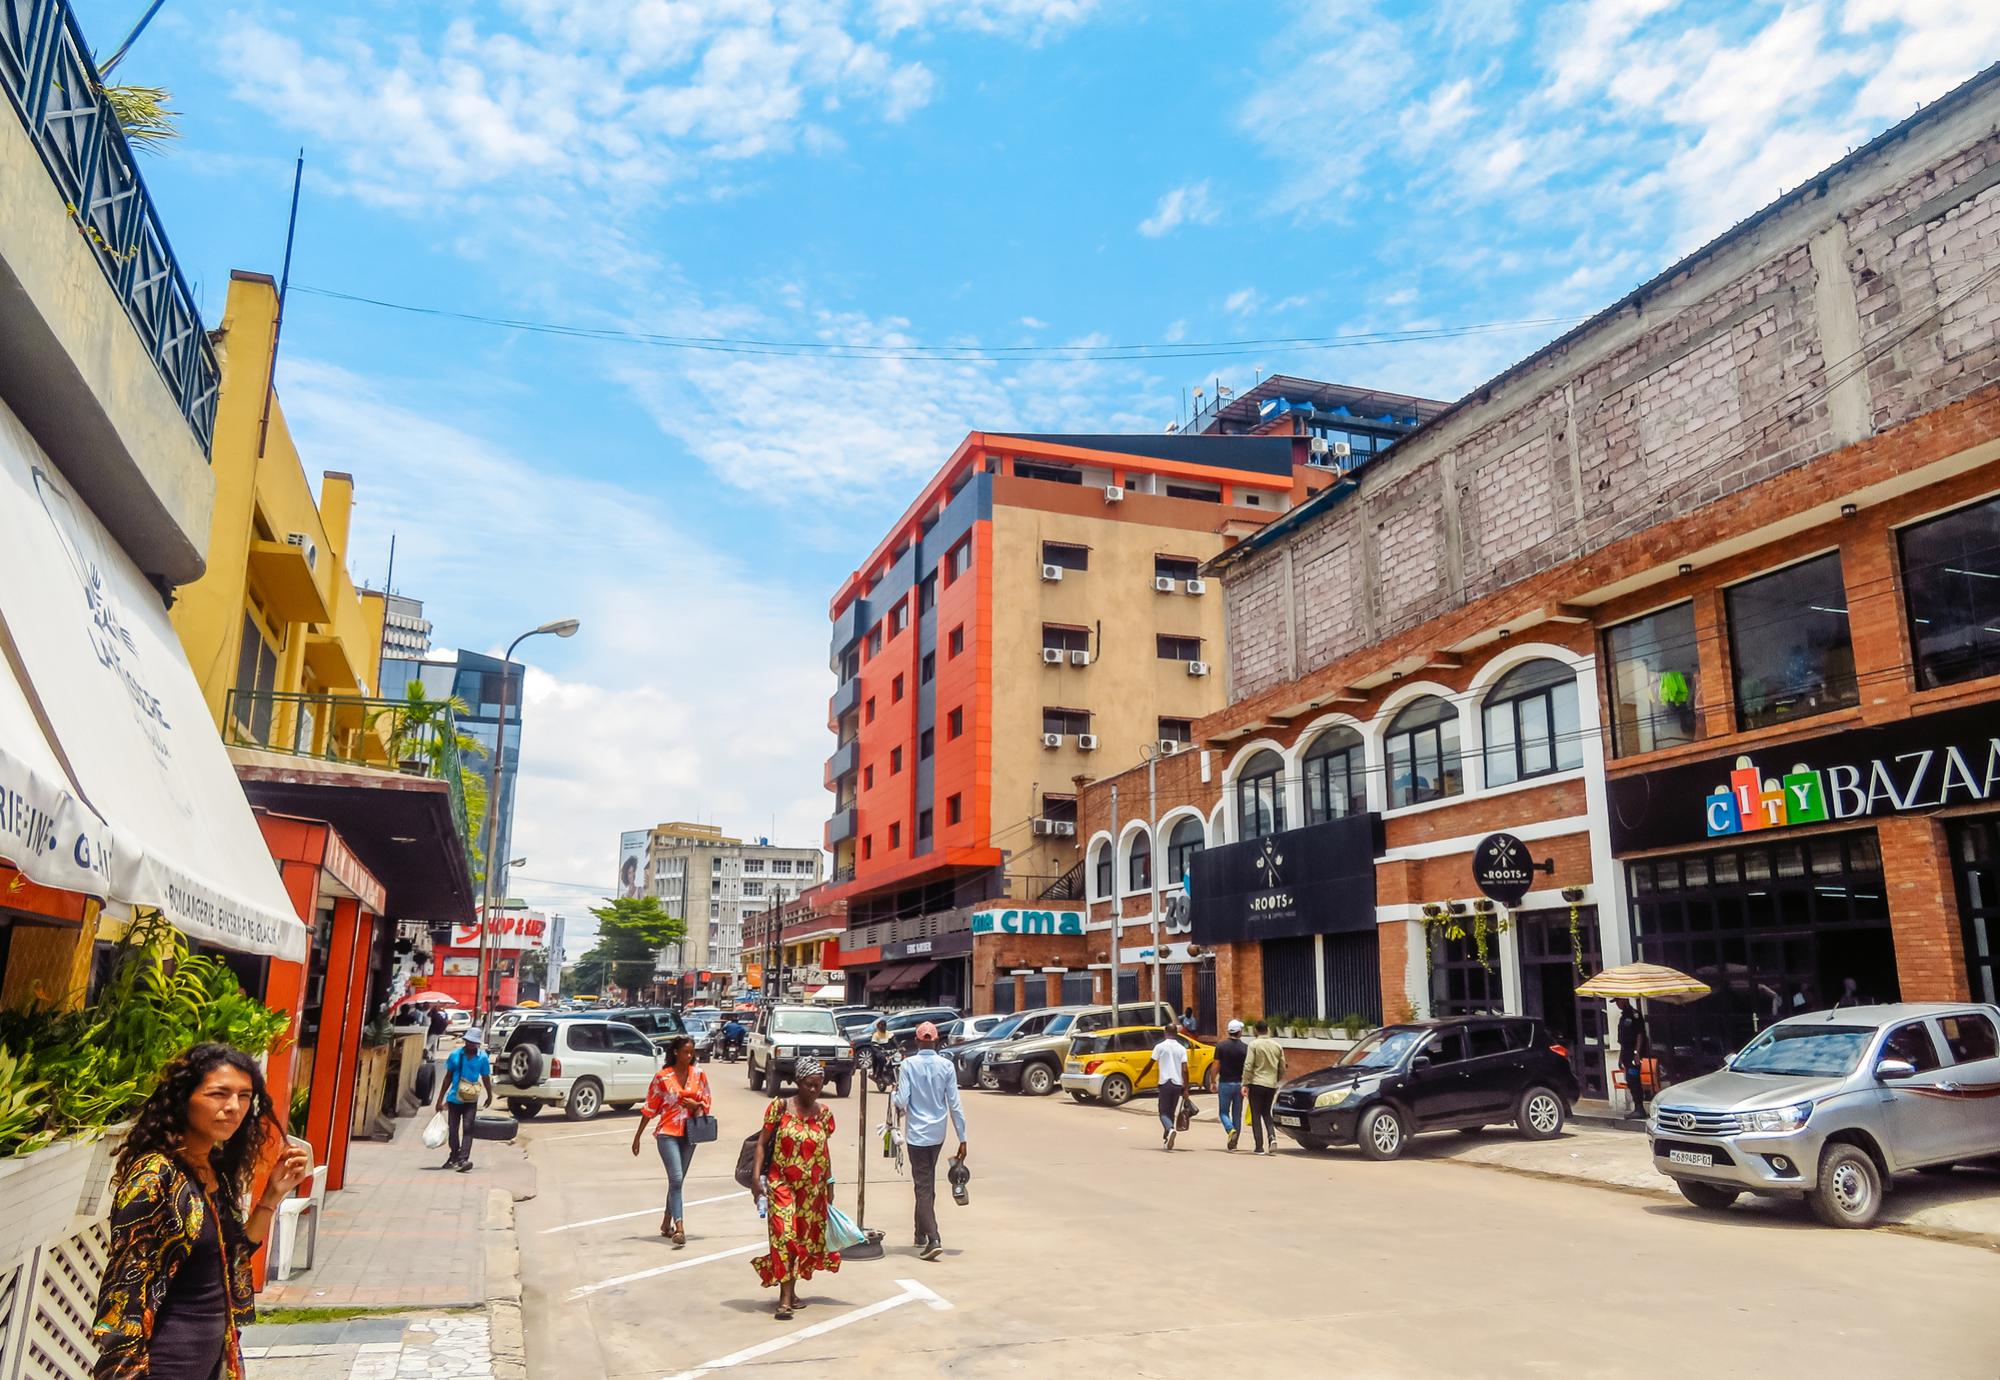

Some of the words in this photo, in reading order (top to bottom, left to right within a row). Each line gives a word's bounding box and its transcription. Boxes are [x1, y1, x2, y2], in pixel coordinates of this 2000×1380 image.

[1708, 783, 1812, 831] CITY
[1489, 870, 1522, 879] ROOTS
[1255, 894, 1287, 911] ROOTS
[1001, 910, 1082, 935] cma
